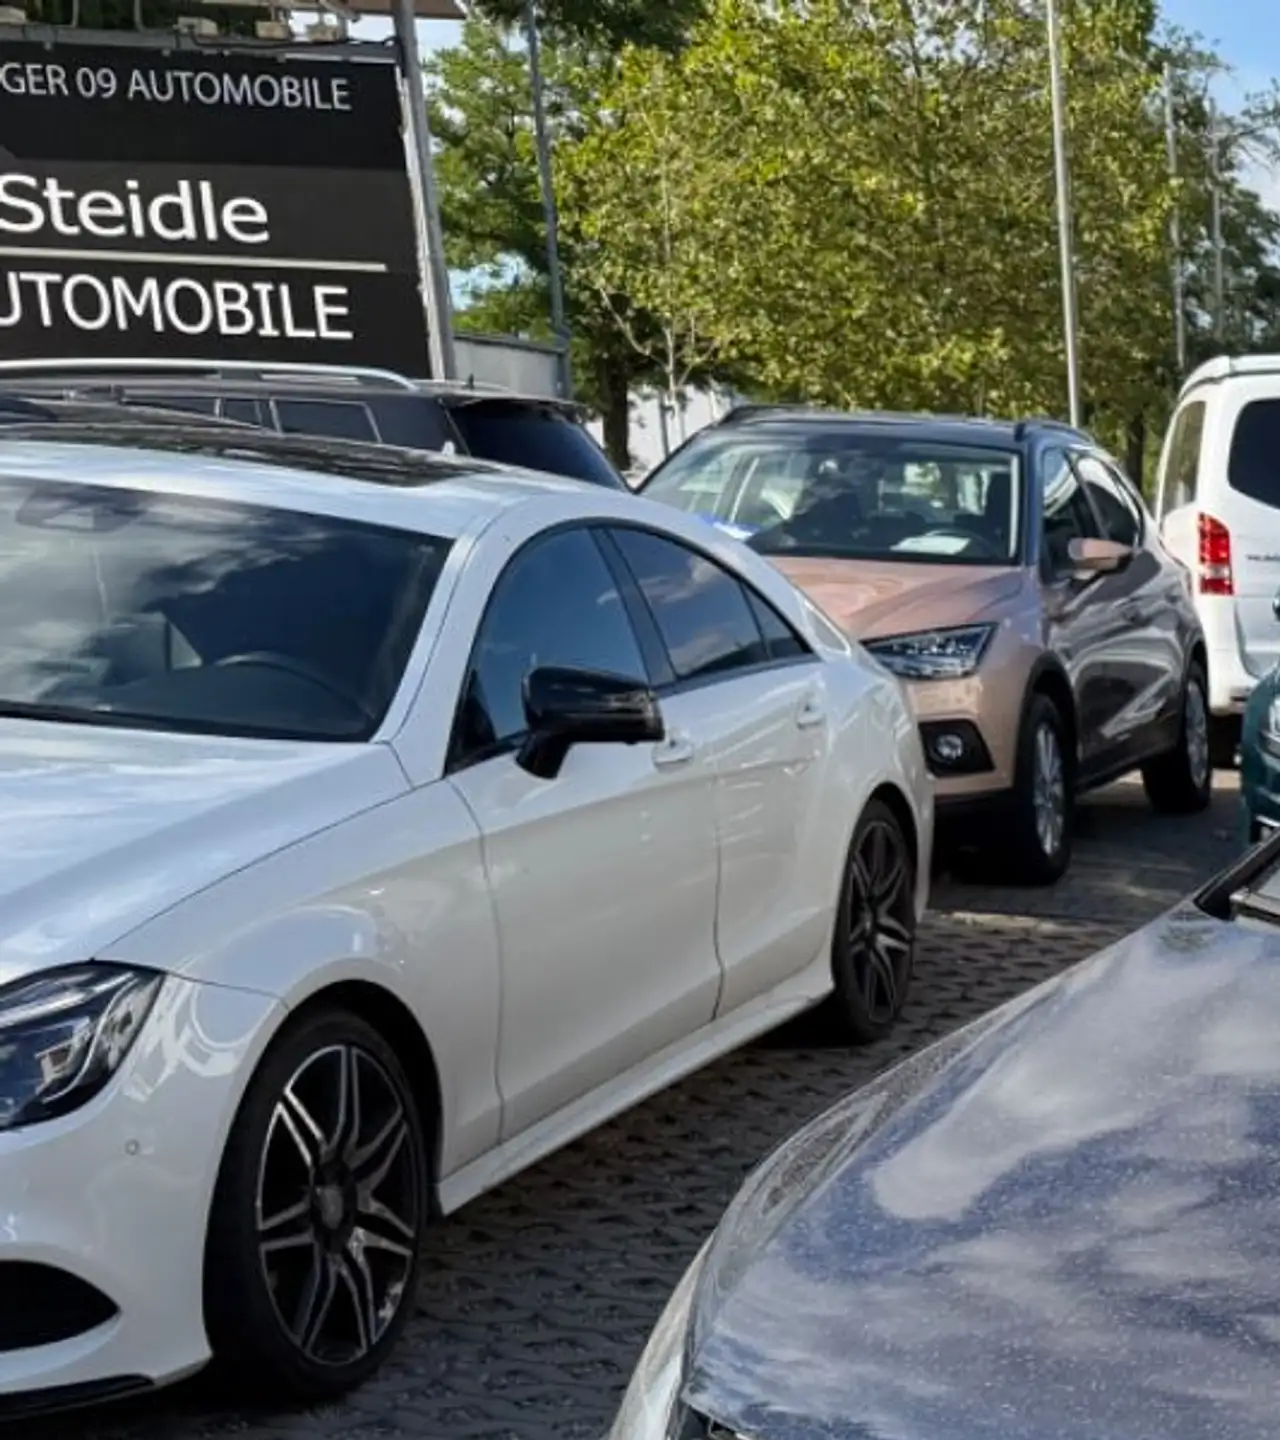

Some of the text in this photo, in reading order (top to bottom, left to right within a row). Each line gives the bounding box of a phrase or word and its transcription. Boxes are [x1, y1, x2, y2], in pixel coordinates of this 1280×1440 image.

[0, 63, 353, 111] GER 09 AUTOMOBILE
[0, 174, 271, 244] Steidle
